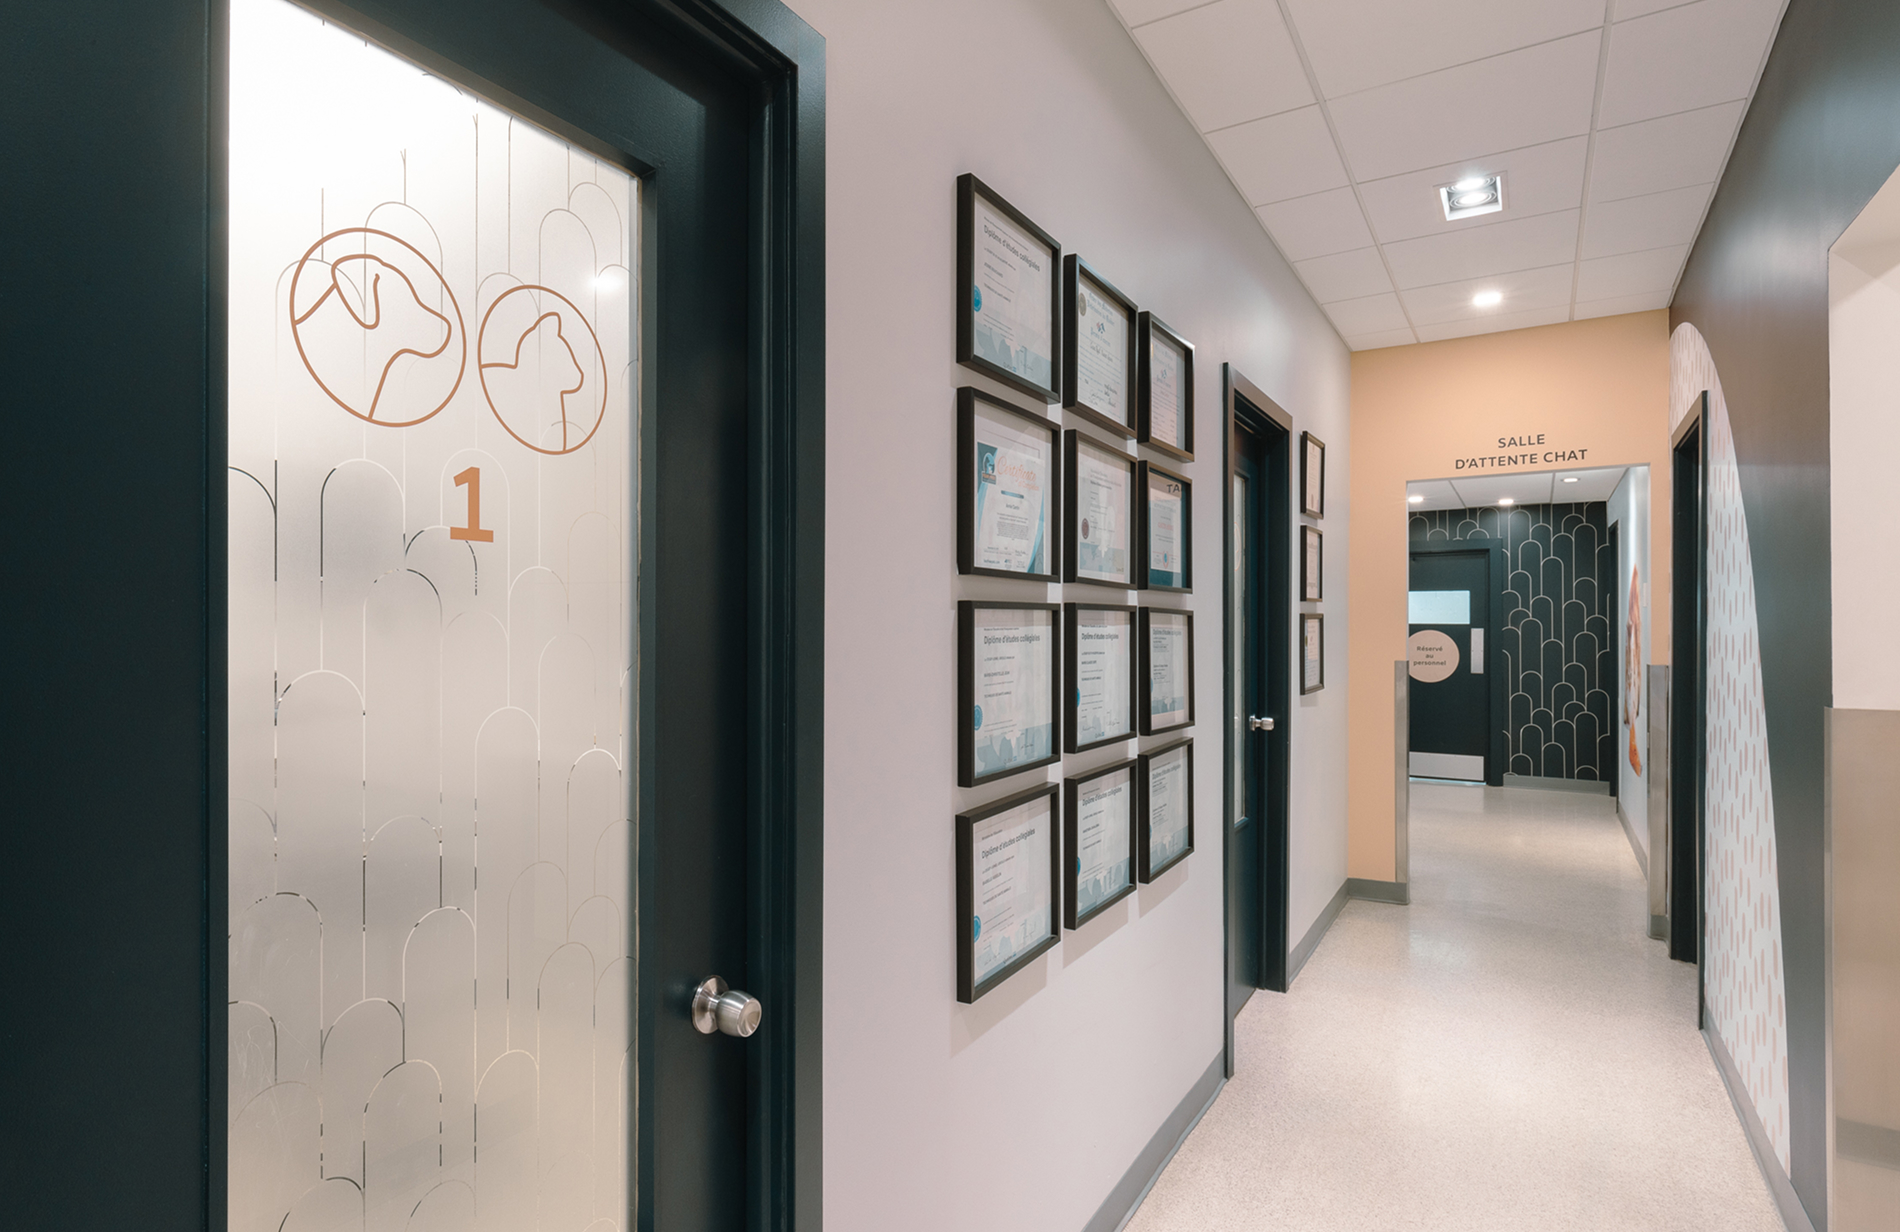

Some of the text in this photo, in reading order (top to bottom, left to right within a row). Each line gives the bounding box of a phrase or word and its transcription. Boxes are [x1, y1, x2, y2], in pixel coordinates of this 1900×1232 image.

[984, 224, 1002, 244] Diplôme
[1002, 239, 1019, 257] d'études
[1019, 252, 1041, 272] collégiales
[1498, 434, 1545, 449] SALLE
[997, 455, 1037, 483] Certificate
[1455, 449, 1588, 470] D'ATTENTE CHAT
[450, 466, 494, 543] 1
[984, 635, 1001, 646] Diplôme
[1002, 635, 1019, 643] d'études
[982, 846, 998, 859] Diplôme
[999, 837, 1015, 851] d'études
[1015, 828, 1036, 843] collégiales
